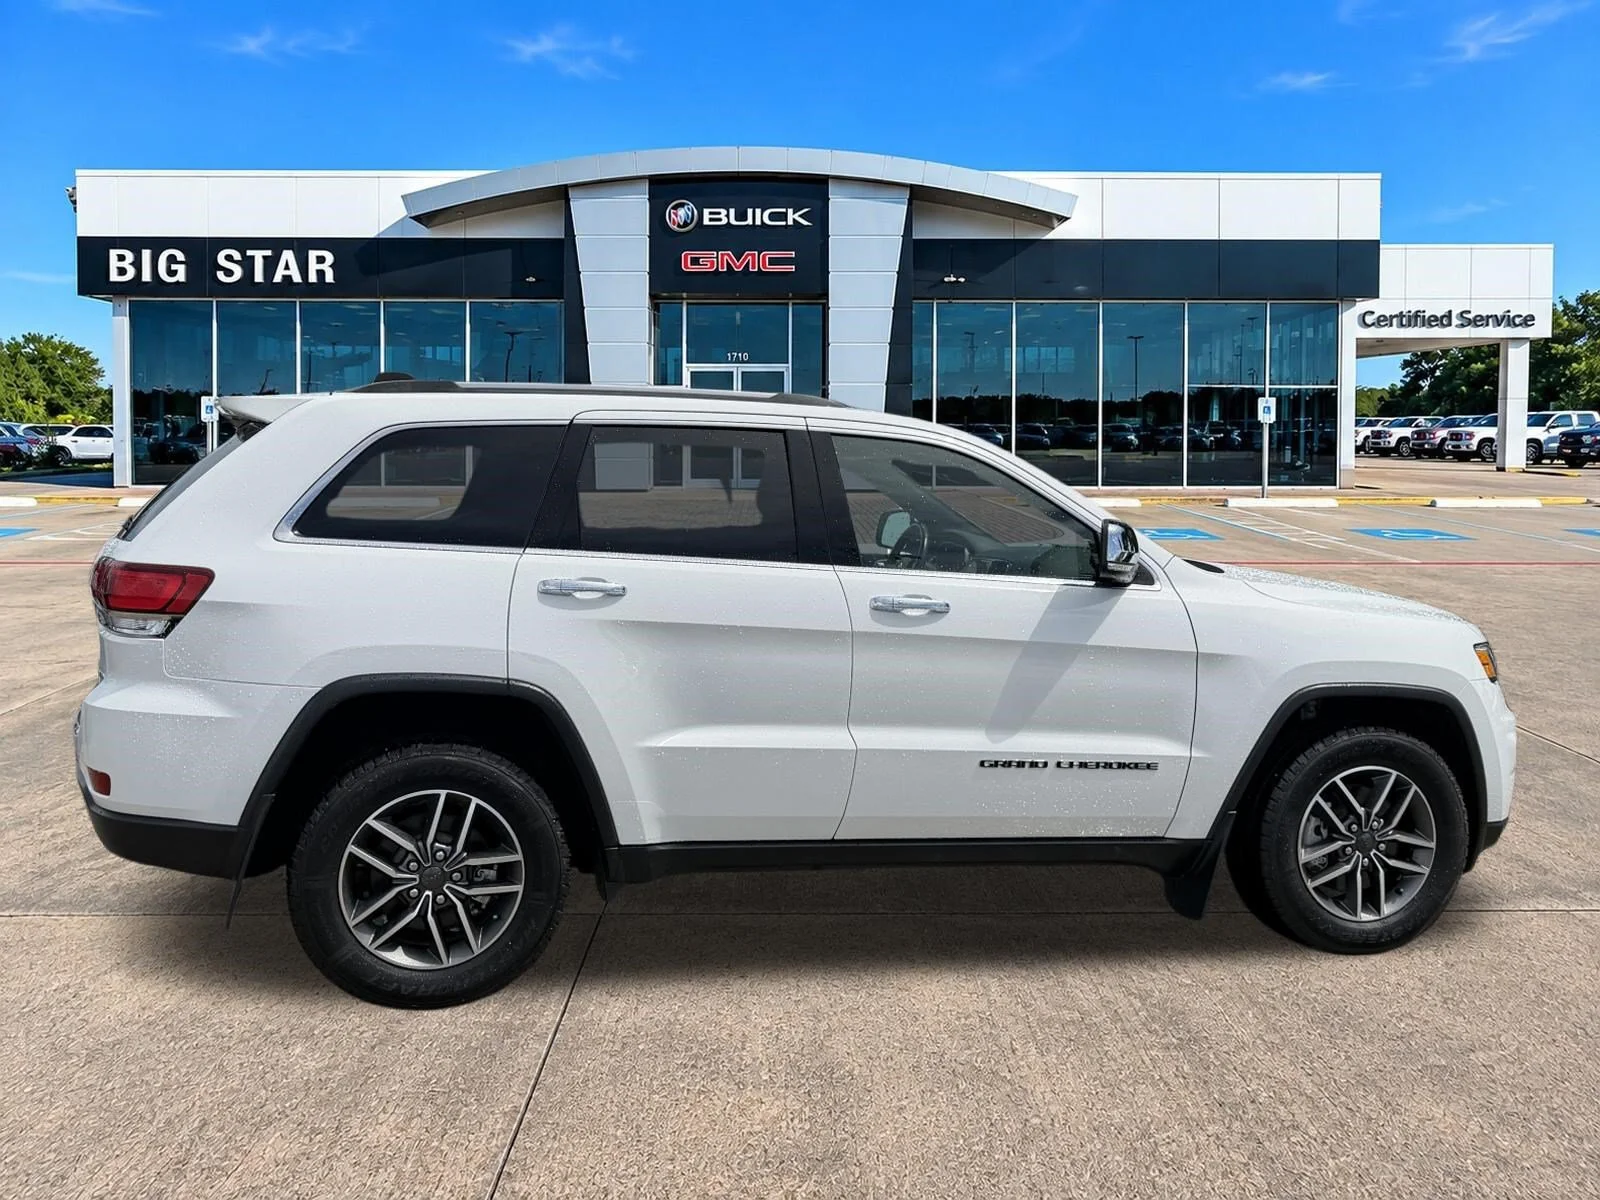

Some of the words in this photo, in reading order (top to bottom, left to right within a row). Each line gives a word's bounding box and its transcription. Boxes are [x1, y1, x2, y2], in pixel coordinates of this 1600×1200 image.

[703, 207, 813, 226] BUICK
[108, 248, 187, 283] BIG
[215, 248, 336, 284] STAR
[681, 251, 796, 272] GMC
[1361, 309, 1453, 329] Certified
[1458, 309, 1536, 329] Service
[727, 352, 749, 362] 1710
[979, 759, 1049, 769] GRAND
[1055, 760, 1159, 771] CHEROKEE
